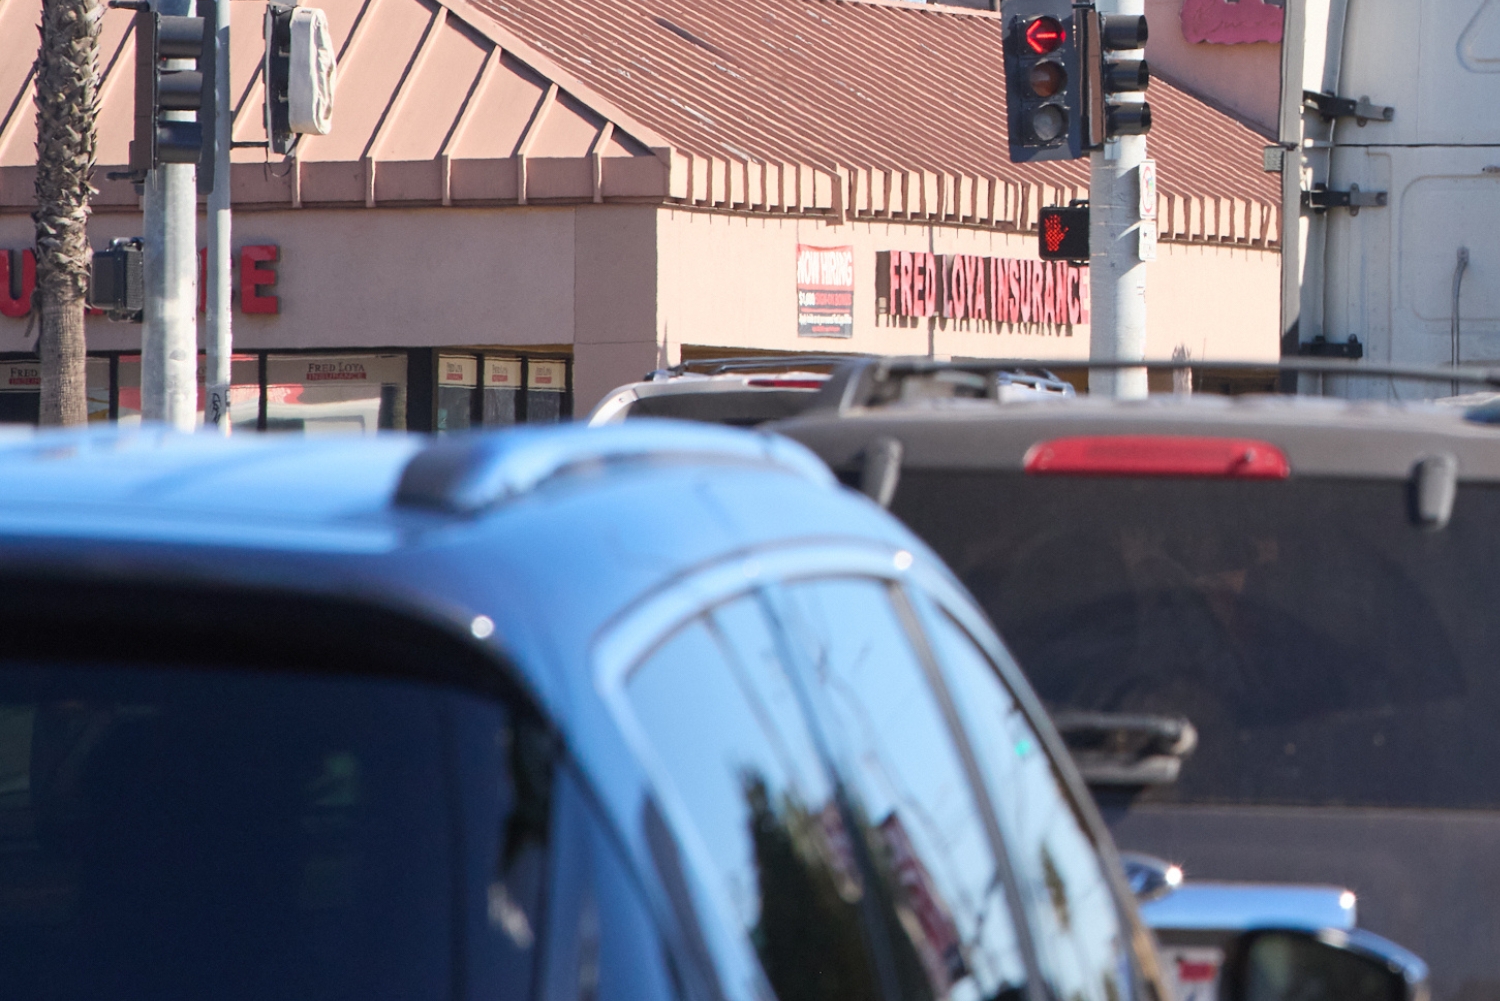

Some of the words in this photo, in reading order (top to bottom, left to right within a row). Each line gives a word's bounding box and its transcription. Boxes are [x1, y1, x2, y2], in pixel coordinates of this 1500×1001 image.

[798, 250, 819, 285] NOW
[821, 250, 853, 287] HIRING
[889, 250, 936, 318] FRED
[941, 253, 987, 321] LOYA
[990, 256, 1089, 325] INSURANCE
